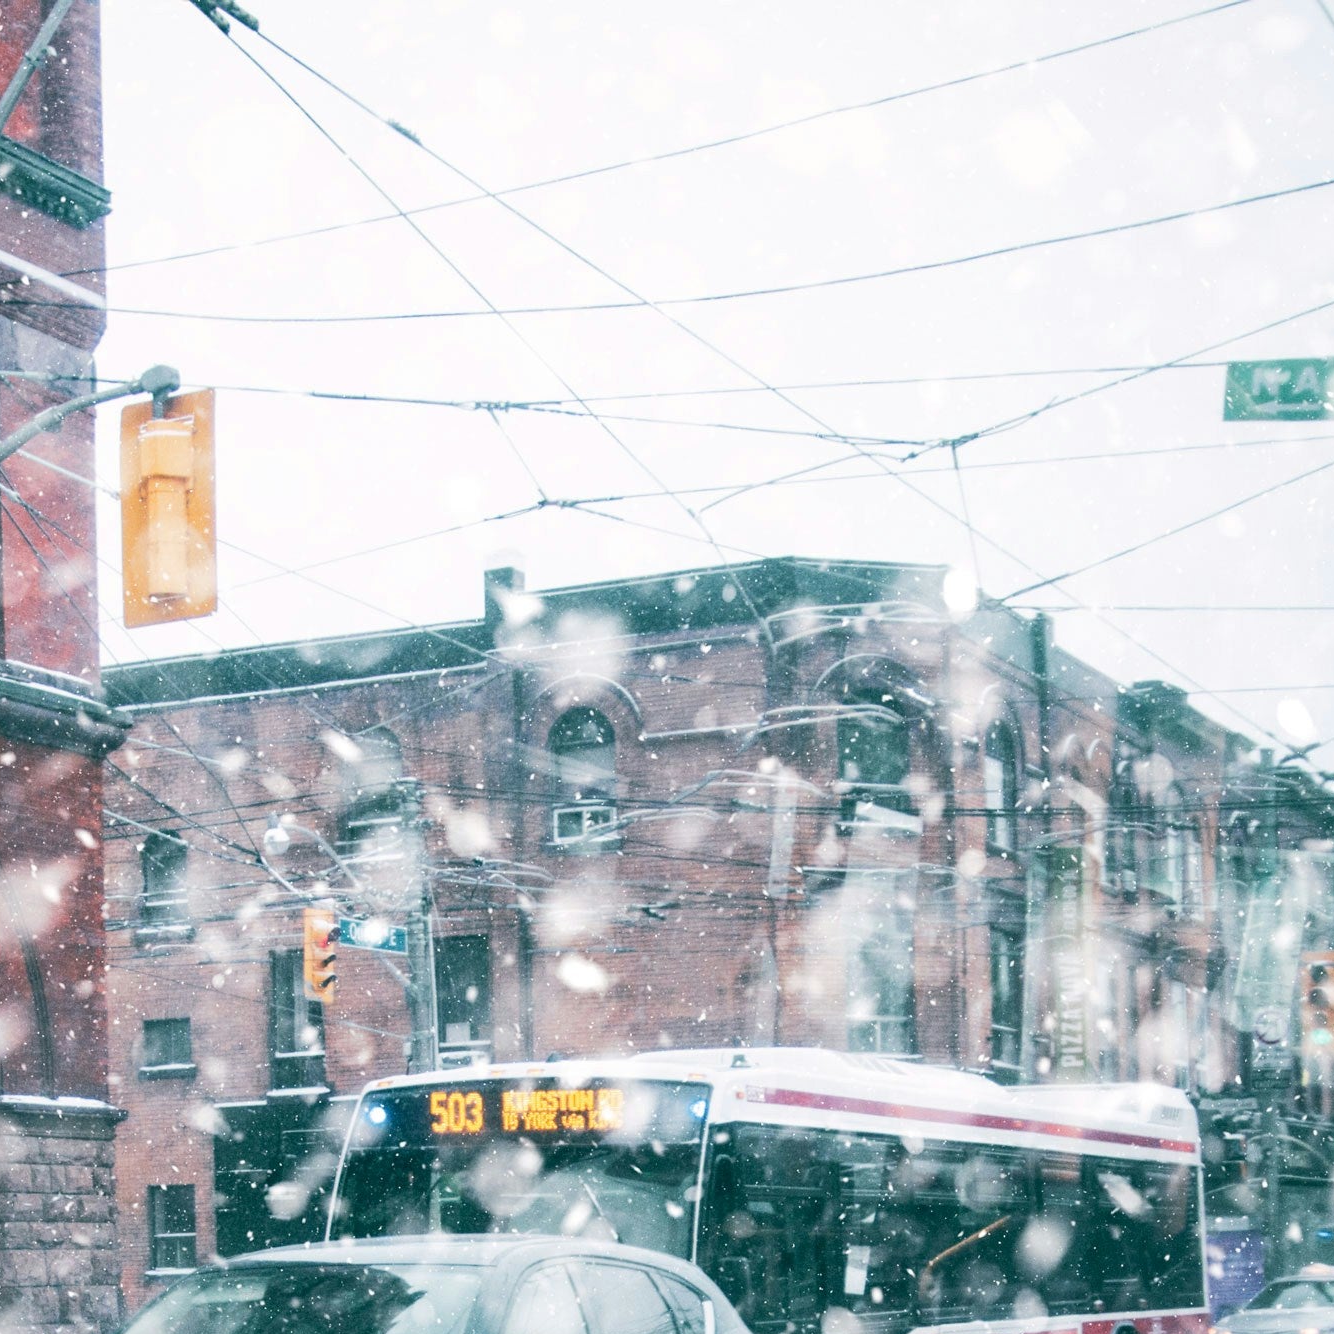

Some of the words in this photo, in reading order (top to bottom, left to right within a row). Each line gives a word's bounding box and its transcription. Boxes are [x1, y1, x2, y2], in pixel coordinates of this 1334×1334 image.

[1060, 1008, 1084, 1068] PIZZA
[430, 1091, 483, 1133] 503
[502, 1089, 594, 1112] KINGSTON
